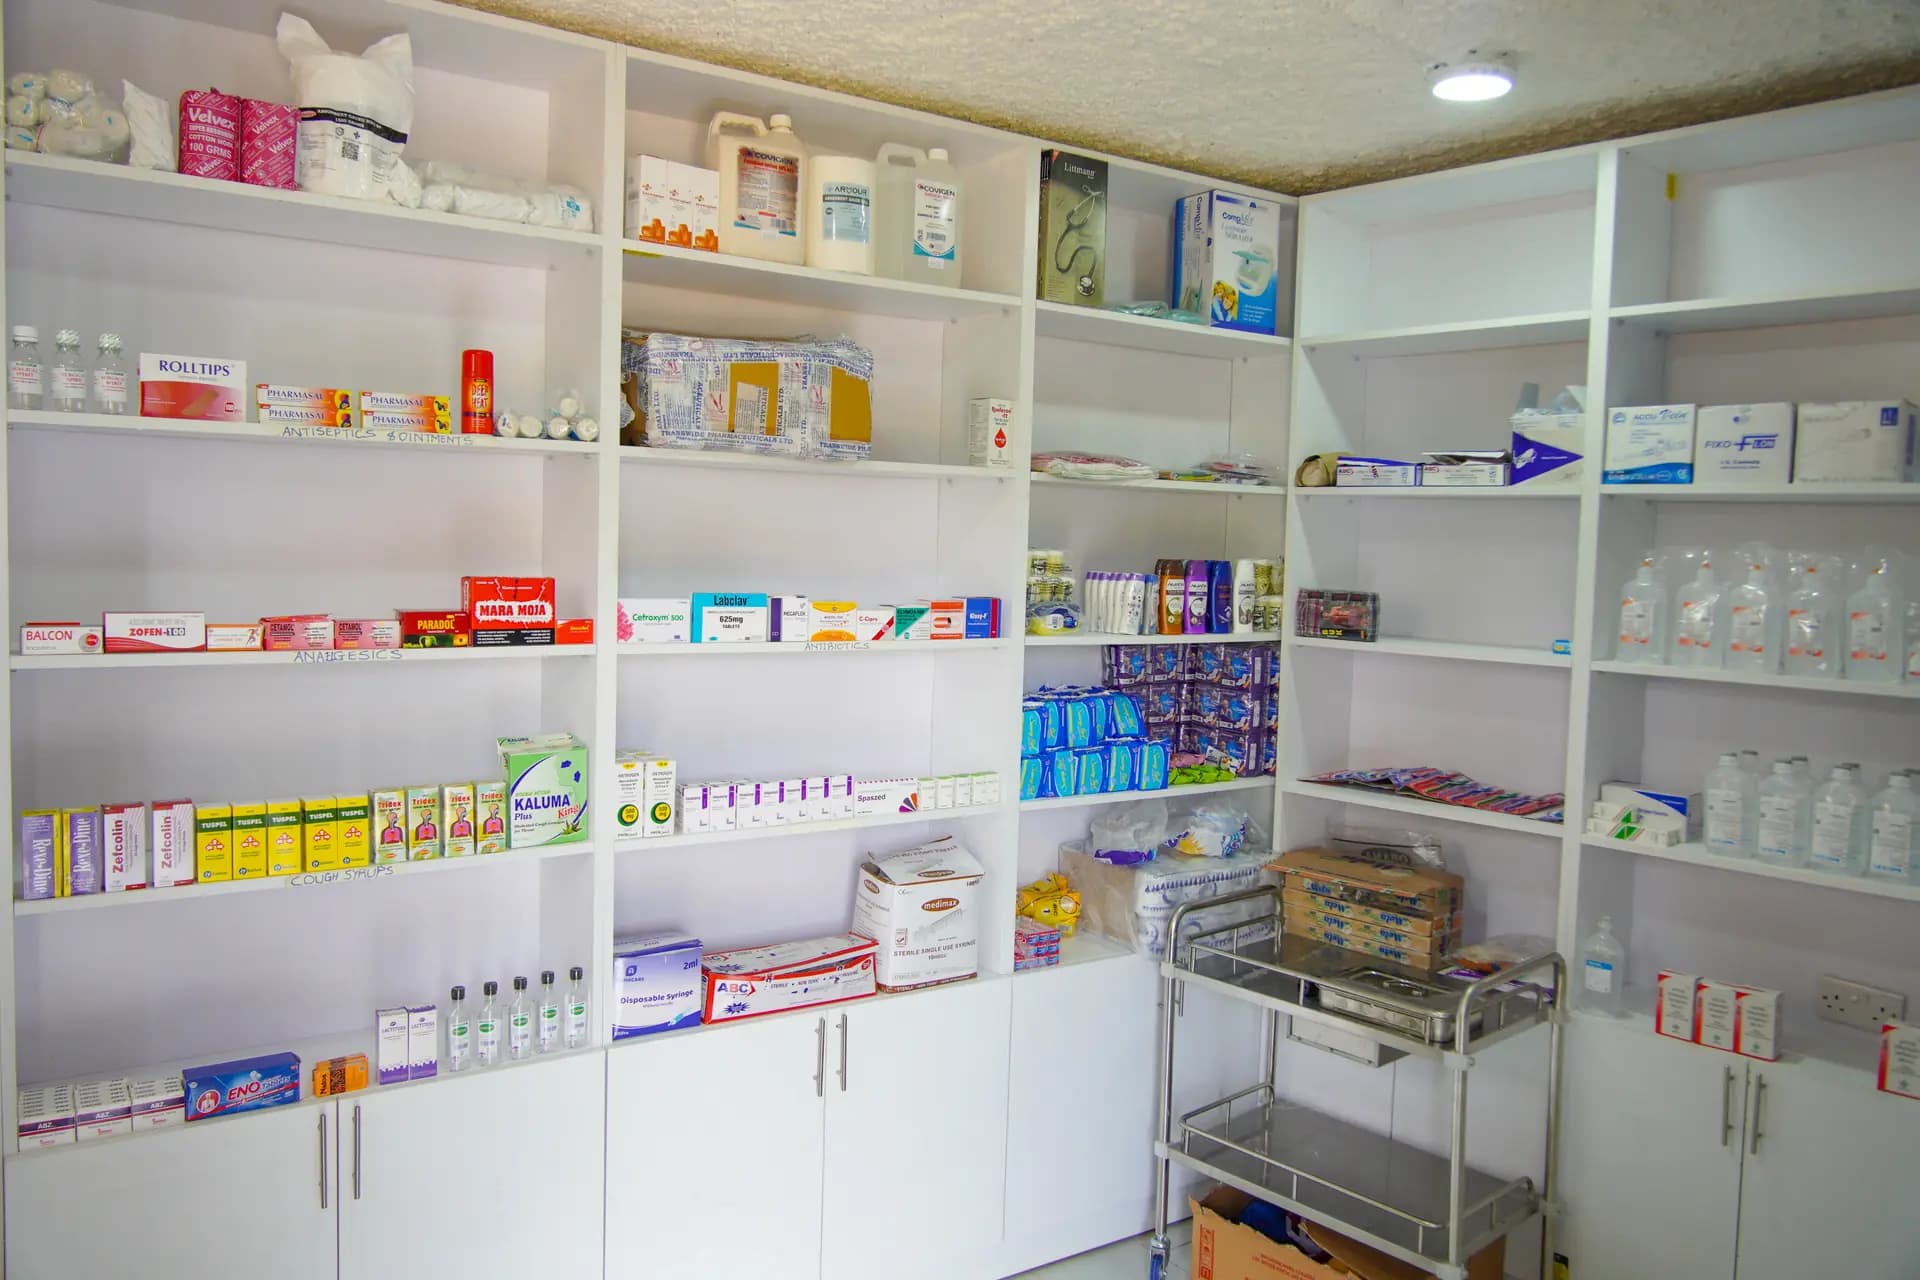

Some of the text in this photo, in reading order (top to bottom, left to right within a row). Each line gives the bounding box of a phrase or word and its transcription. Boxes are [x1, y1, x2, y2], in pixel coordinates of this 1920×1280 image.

[189, 107, 235, 130] Velvex
[252, 114, 280, 135] Velvex
[188, 134, 216, 143] COTTON
[190, 143, 232, 160] 100 GRMS
[269, 137, 293, 154] Velvex
[753, 151, 794, 165] COVIGEN
[1064, 161, 1096, 177] Littmann
[923, 184, 956, 198] COVIGEN
[159, 359, 230, 377] ROLLTIPS
[266, 388, 324, 401] PHARMASAL
[370, 396, 424, 408] PHARMASAL
[268, 408, 325, 421] PHARMASAL
[371, 414, 425, 426] PHARMASAL
[282, 426, 376, 440] ANTISEPTICS
[399, 432, 473, 446] OINTMENTS
[661, 430, 705, 438] TRANSWIDE
[1704, 440, 1732, 448] FIXO
[713, 595, 748, 607] Labclav
[479, 604, 546, 617] MARA MOJA
[632, 613, 684, 622] Cefroxym 500
[719, 615, 744, 624] 625mg
[417, 619, 455, 630] PARADOL
[26, 629, 73, 641] BALCON
[128, 627, 186, 637] ZOFEN-100
[805, 642, 870, 650] ANTIBIOTICS
[412, 798, 437, 806] Tridex
[481, 792, 504, 800] Tridex
[378, 801, 402, 810] Tridex
[515, 794, 570, 811] KALUMA
[309, 812, 334, 820] TUSPEL
[341, 809, 365, 817] TUSPEL
[515, 813, 533, 821] Plus
[201, 820, 228, 829] TUSPEL
[237, 818, 263, 826] TUSPEL
[272, 815, 297, 824] TUSPEL
[112, 819, 123, 873] Zefcolin
[161, 816, 172, 869] Zefcolin
[290, 865, 394, 886] COUGH SYRUPS
[924, 899, 957, 910] medimax
[894, 949, 920, 957] STERILE
[921, 946, 942, 954] SINGLE
[683, 958, 698, 970] 2ml
[717, 982, 750, 993] ABC
[620, 989, 694, 1005] Disposable Syringe
[228, 1081, 261, 1101] ENO
